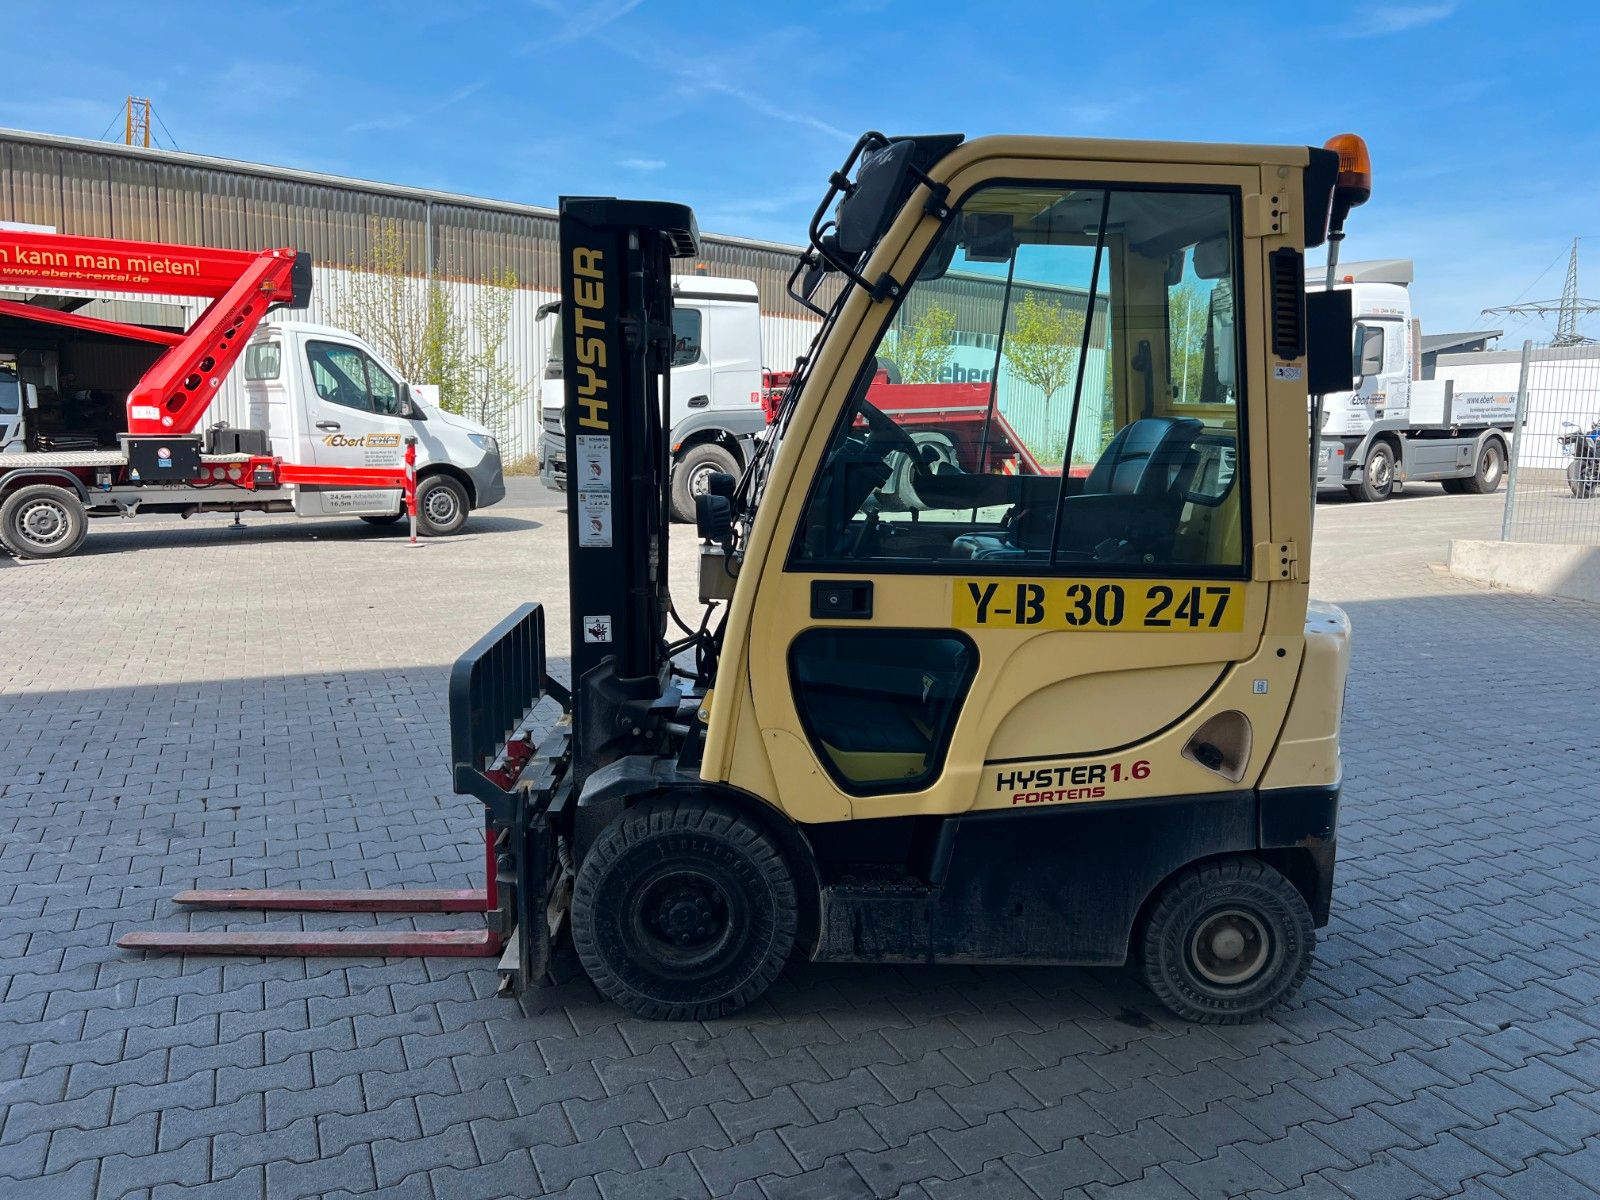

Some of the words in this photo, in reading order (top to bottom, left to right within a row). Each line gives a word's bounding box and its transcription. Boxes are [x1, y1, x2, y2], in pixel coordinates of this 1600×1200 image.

[2, 267, 150, 284] www.ebert-rental.de
[15, 245, 69, 267] kann
[75, 254, 120, 271] man
[127, 255, 200, 276] mieten!
[572, 247, 609, 430] HYSTER
[330, 434, 365, 447] Ebert
[967, 583, 1045, 624] Y-B
[1065, 584, 1125, 626] 30
[1144, 585, 1231, 627] 247
[996, 764, 1107, 791] HYSTER
[1110, 760, 1150, 782] 1.6
[1012, 786, 1106, 805] FORTENS
